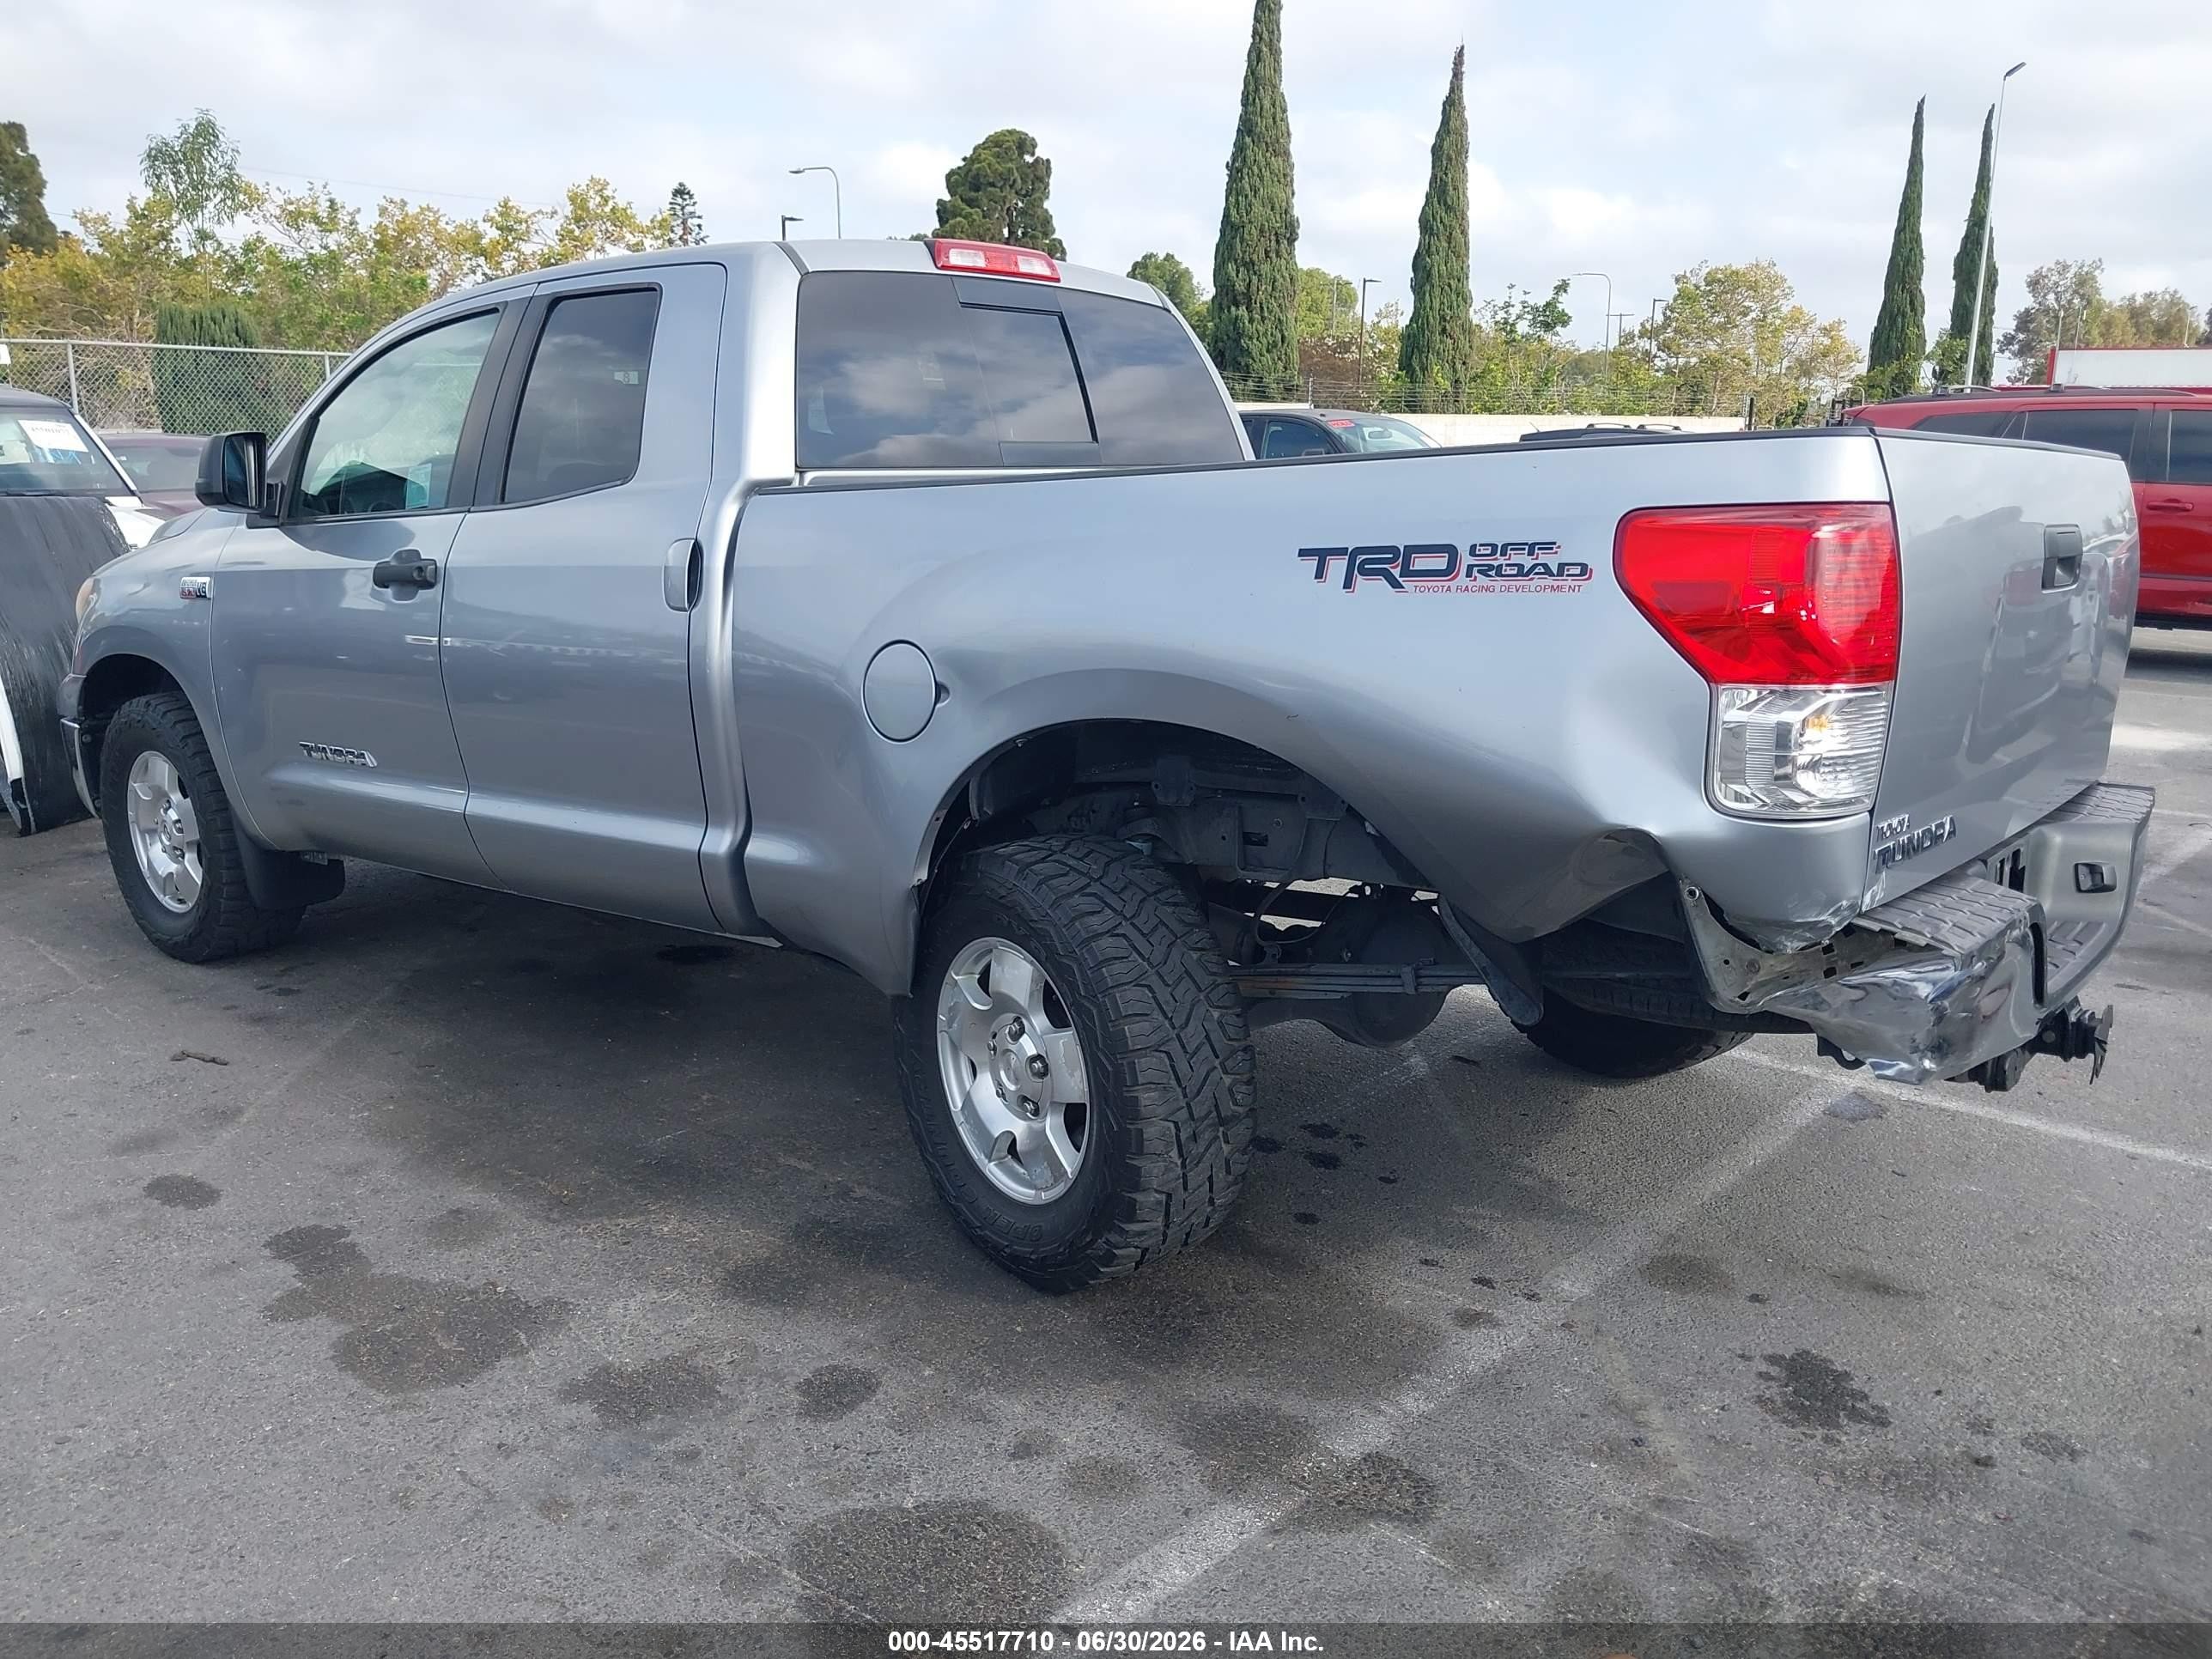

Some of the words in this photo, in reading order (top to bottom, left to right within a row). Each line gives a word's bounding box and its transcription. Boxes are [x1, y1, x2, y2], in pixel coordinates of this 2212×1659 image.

[1468, 541, 1561, 560] OFF
[1297, 544, 1462, 593] TRD
[1465, 562, 1593, 581] ROAD
[1413, 585, 1452, 593] TOYOTA
[1455, 584, 1496, 593] RACING
[1499, 584, 1583, 593] DEVELOPMENT
[299, 741, 378, 767] TUNDRA
[1874, 815, 1957, 874] TUNDRA
